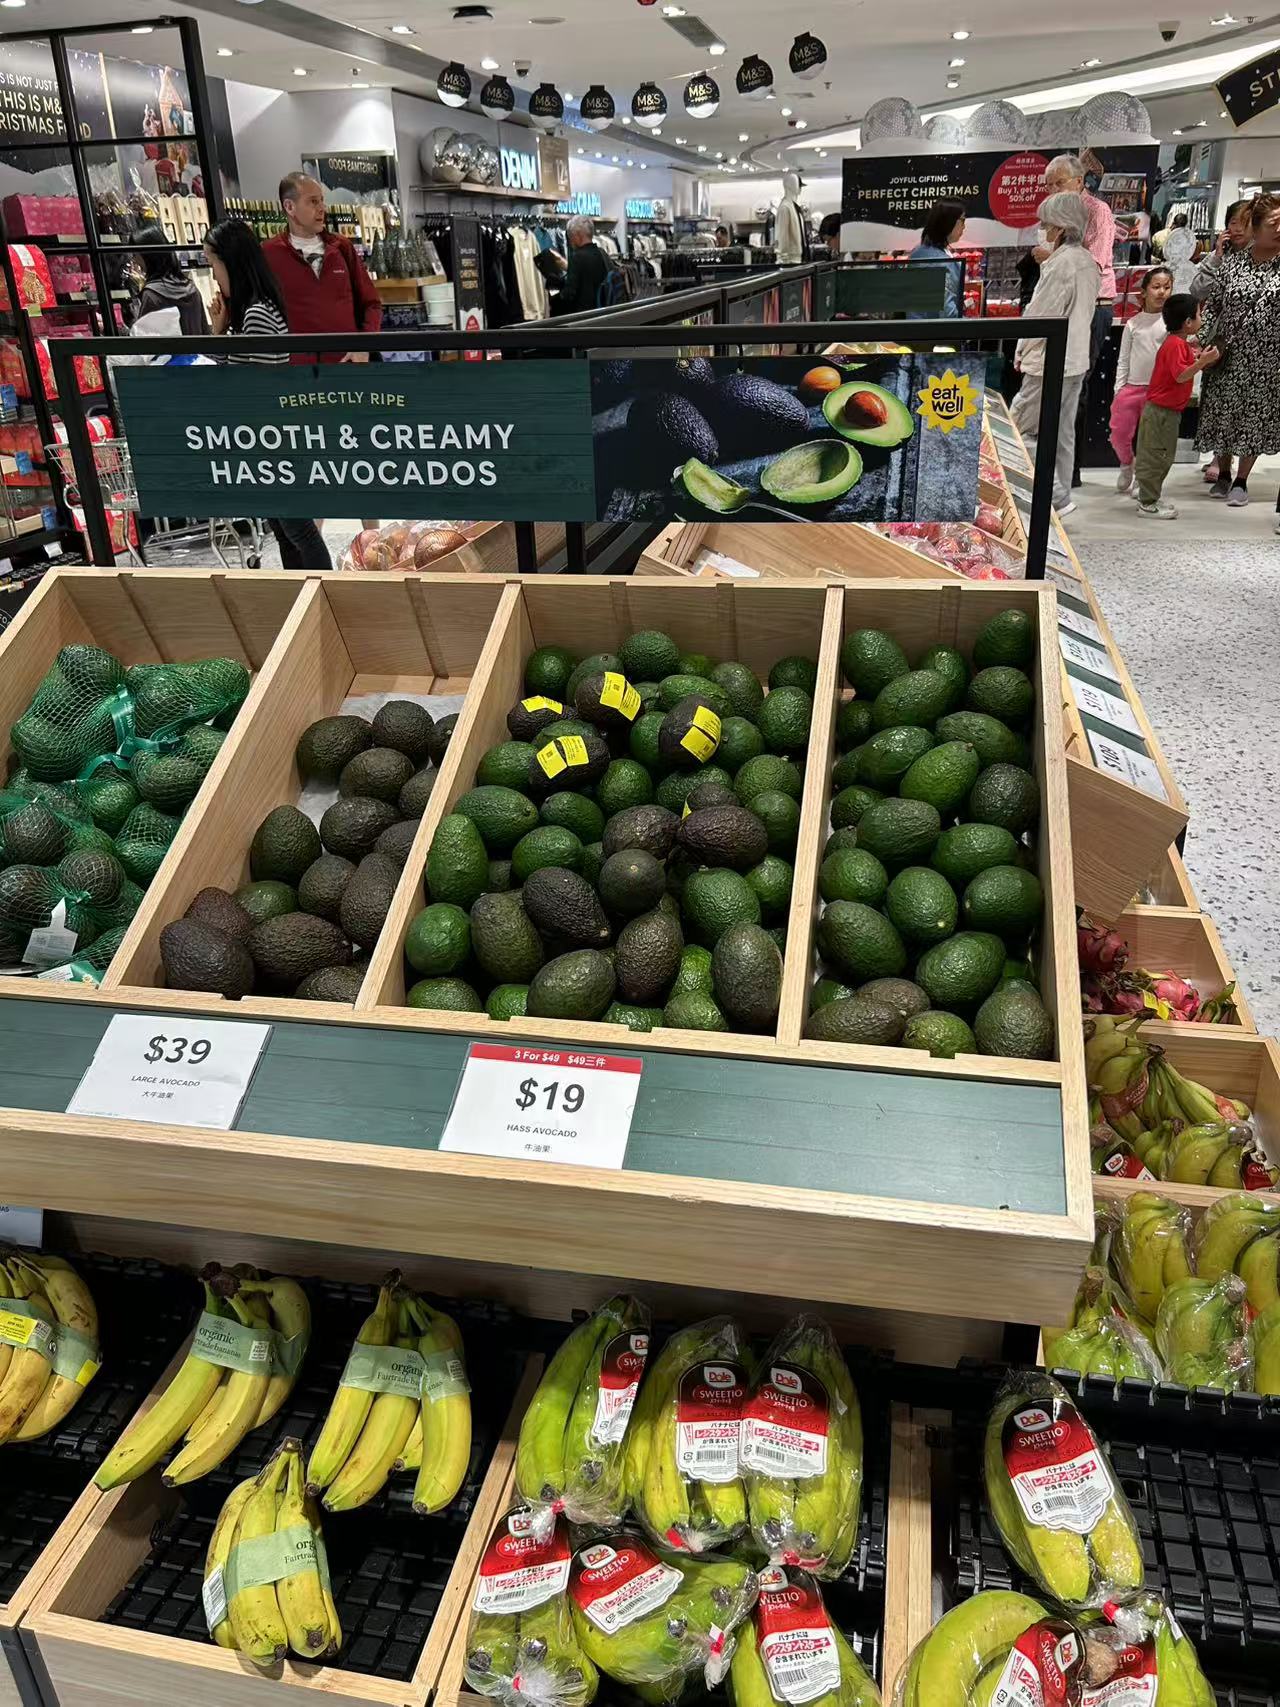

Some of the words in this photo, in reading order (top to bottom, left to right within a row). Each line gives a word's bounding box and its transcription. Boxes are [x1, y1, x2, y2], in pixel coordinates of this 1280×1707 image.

[16, 75, 33, 88] NOT
[35, 79, 53, 92] JUST
[28, 94, 41, 113] IS
[43, 96, 63, 115] M&
[0, 112, 55, 135] RISTMAS
[500, 149, 538, 191] DENIM
[858, 188, 909, 200] PERFECT
[911, 185, 980, 198] CHRISTMAS
[997, 187, 1012, 196] Buy
[1020, 187, 1033, 195] get
[279, 391, 364, 408] PERFECTLY
[370, 392, 405, 408] RIPE
[932, 384, 960, 400] eat
[932, 396, 964, 412] well
[185, 424, 327, 451] SMOOTH
[339, 424, 360, 450] &
[369, 423, 515, 450] CREAMY
[210, 459, 296, 486] HASS
[308, 459, 498, 486] AVOCADOS
[143, 1034, 212, 1065] $39
[514, 1050, 521, 1060] 3
[522, 1051, 540, 1061] For
[541, 1052, 561, 1063] $49
[159, 1077, 201, 1087] AVOCADO
[515, 1077, 585, 1113] $19
[506, 1124, 531, 1134] HASS
[533, 1127, 578, 1138] AVOCADO
[524, 1143, 551, 1153] 牛油果
[199, 1327, 235, 1345] organic
[709, 1371, 731, 1382] Dole
[775, 1373, 798, 1388] Dole
[699, 1389, 743, 1399] SWEETIO
[763, 1390, 808, 1408] SWEETIO
[1020, 1411, 1046, 1427] Dole
[696, 1429, 739, 1438] レジスタントス
[1018, 1427, 1064, 1447] SWEETIO
[587, 1548, 611, 1563] Dole
[587, 1555, 630, 1580] SWEETIO
[760, 1591, 800, 1607] WEETIO
[1041, 1640, 1061, 1689] SWEETIO
